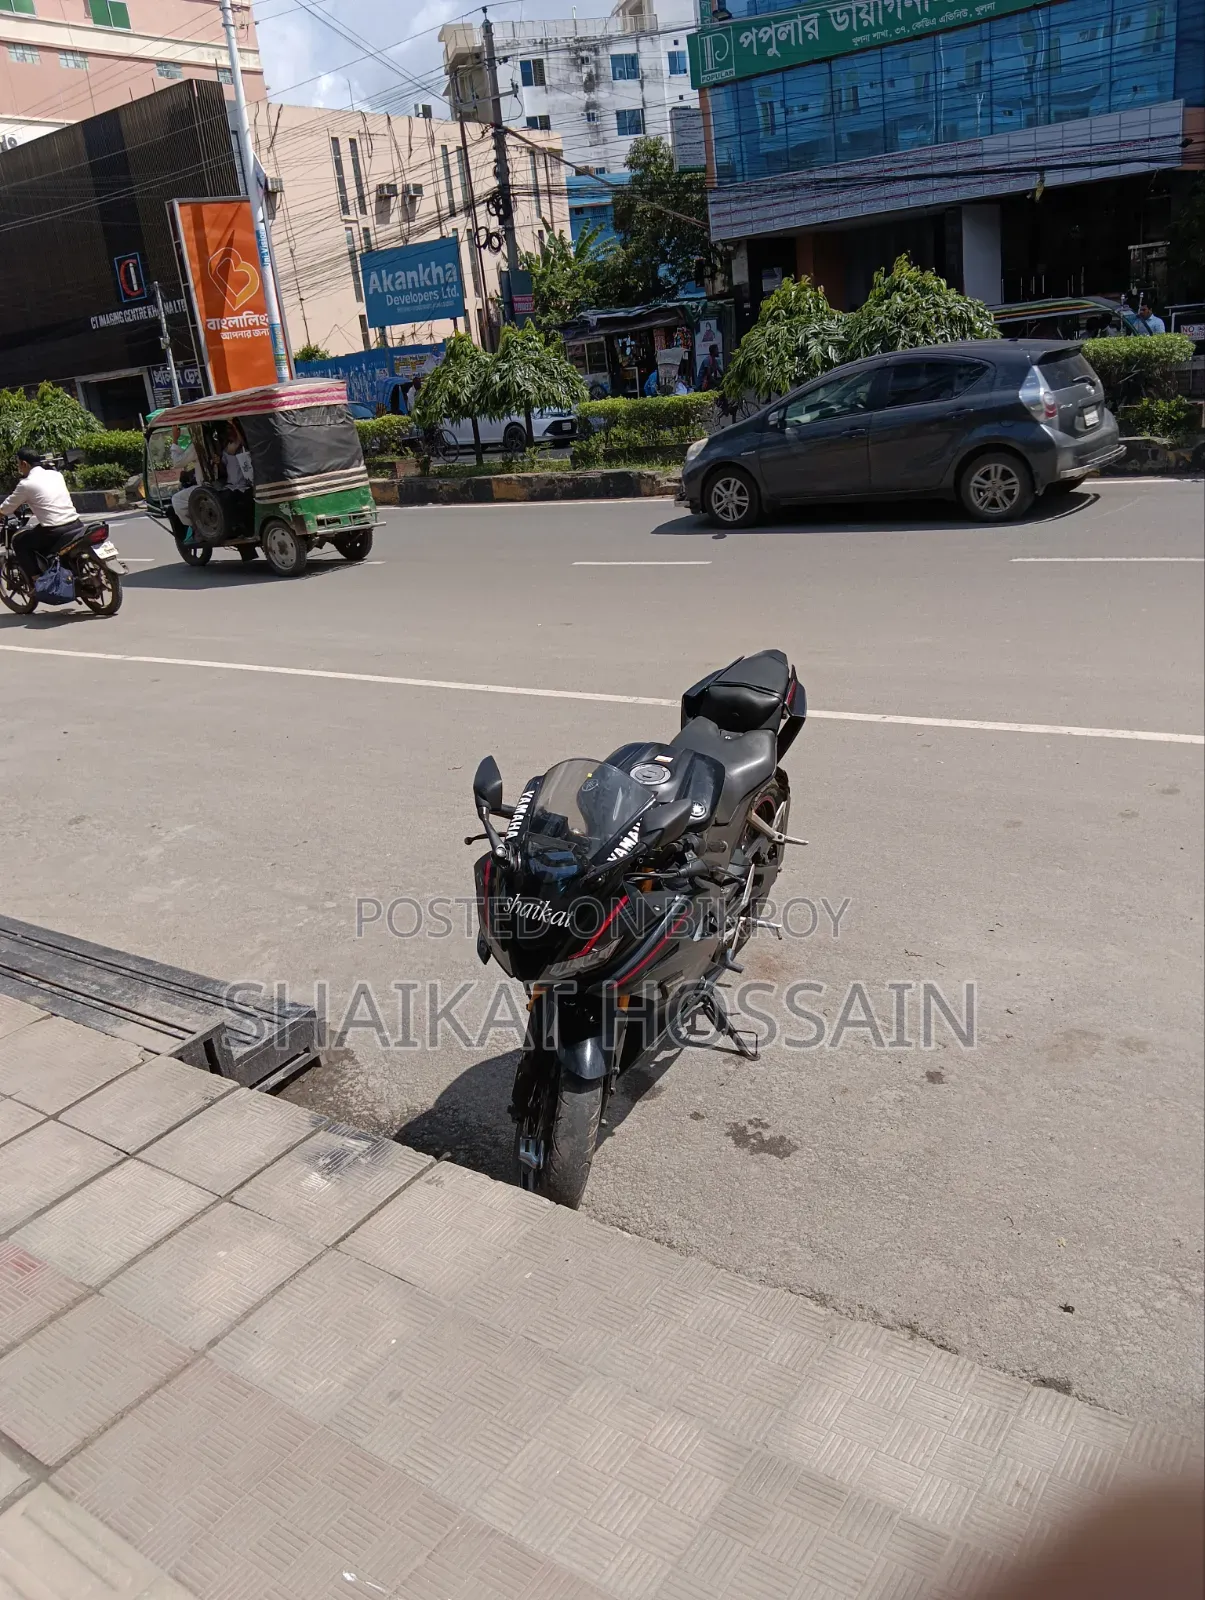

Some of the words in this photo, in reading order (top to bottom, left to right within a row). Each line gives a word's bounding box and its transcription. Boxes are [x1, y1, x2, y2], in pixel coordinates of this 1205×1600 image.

[974, 1, 996, 16] খুলনা
[739, 12, 820, 58] পপুলার
[702, 70, 735, 83] POPULAR
[368, 261, 458, 295] Akankha
[385, 289, 440, 307] Developers
[441, 284, 460, 299] Ltd.
[99, 310, 125, 327] IMAGING
[123, 305, 148, 322] CENTRE
[147, 301, 174, 319] KHNA
[220, 329, 252, 340] আপনার
[505, 790, 535, 840] YAMAHA
[503, 893, 575, 928] shaikat
